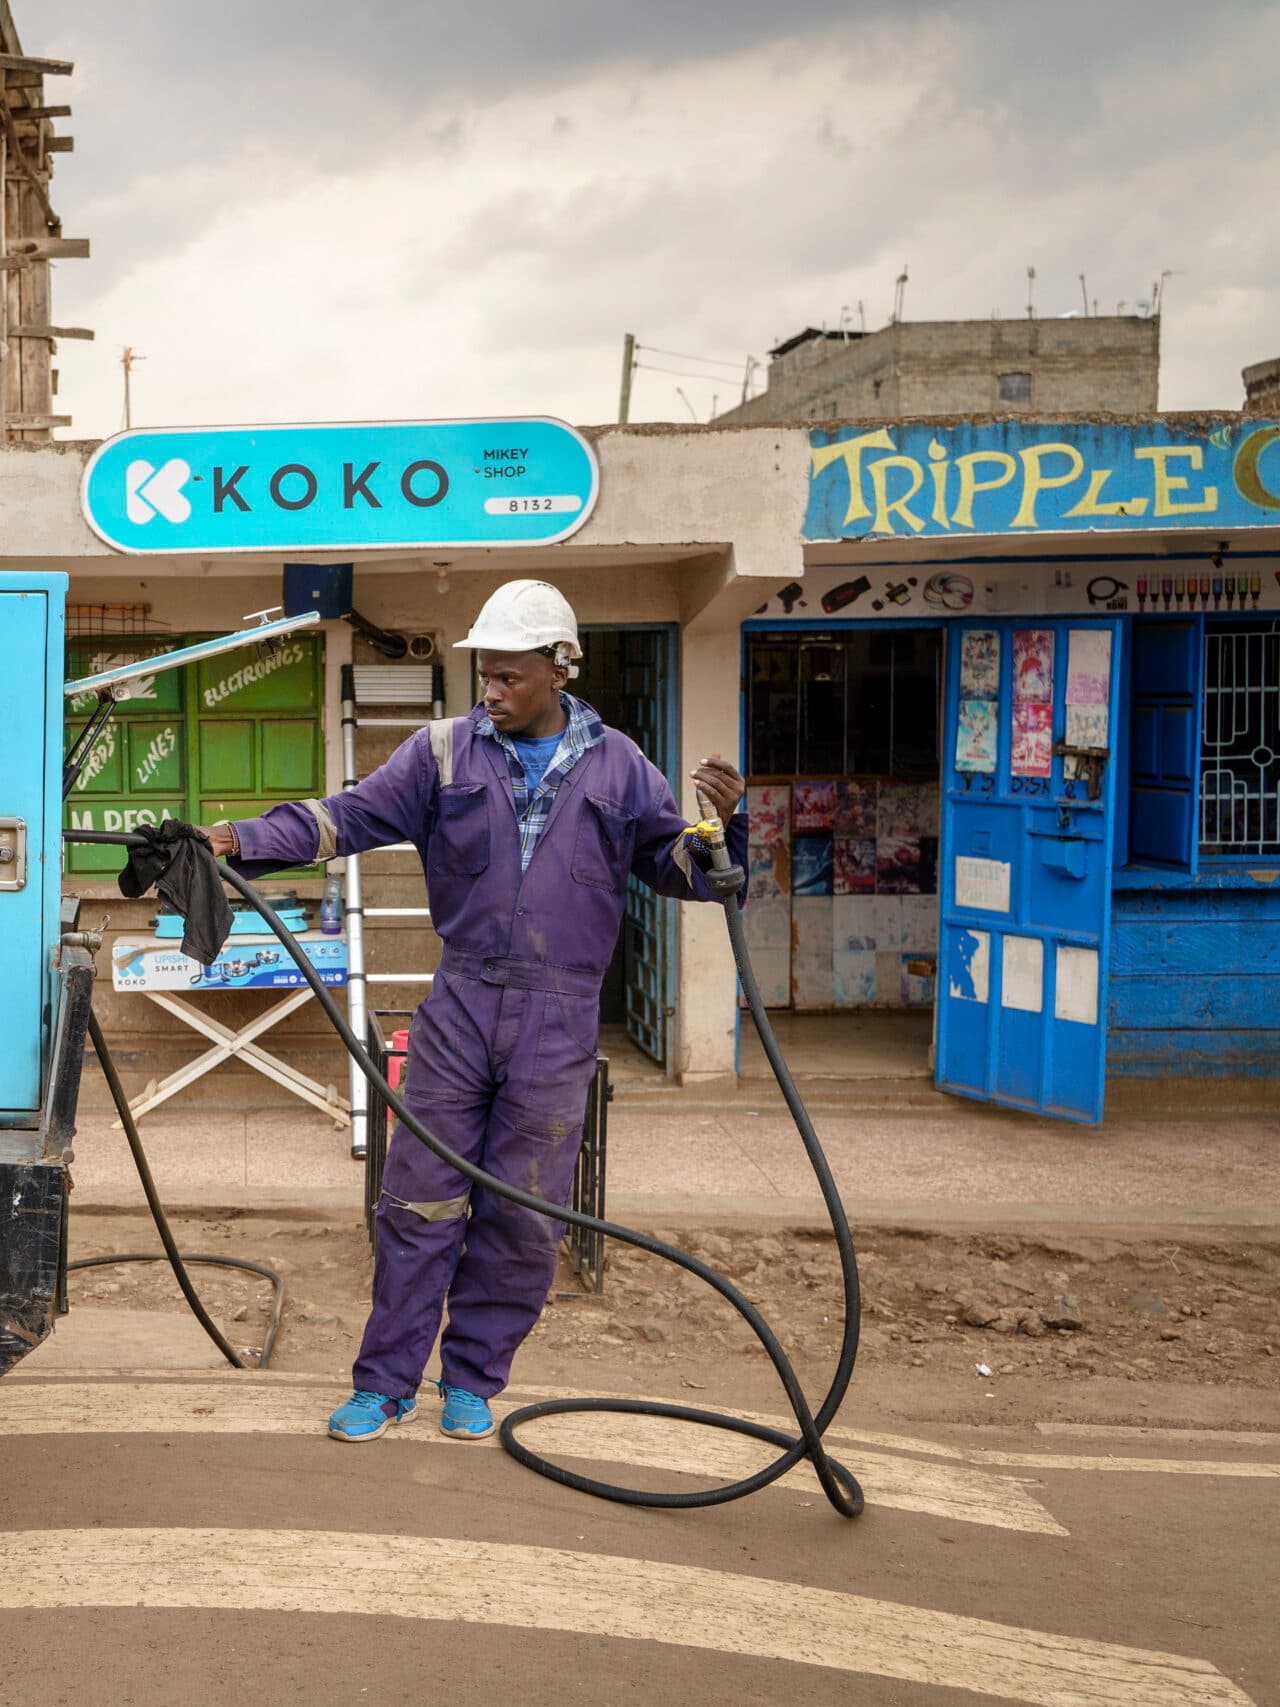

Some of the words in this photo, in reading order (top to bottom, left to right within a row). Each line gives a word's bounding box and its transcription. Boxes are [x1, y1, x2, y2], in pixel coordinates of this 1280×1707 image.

[483, 447, 529, 461] MIKEY
[483, 465, 527, 479] SHOP
[212, 459, 450, 513] KOKO
[508, 498, 553, 512] 8132
[203, 644, 304, 707] ELECTRONICS
[136, 727, 176, 785] LINES
[154, 964, 189, 973] SMART
[117, 978, 146, 986] KOKO
